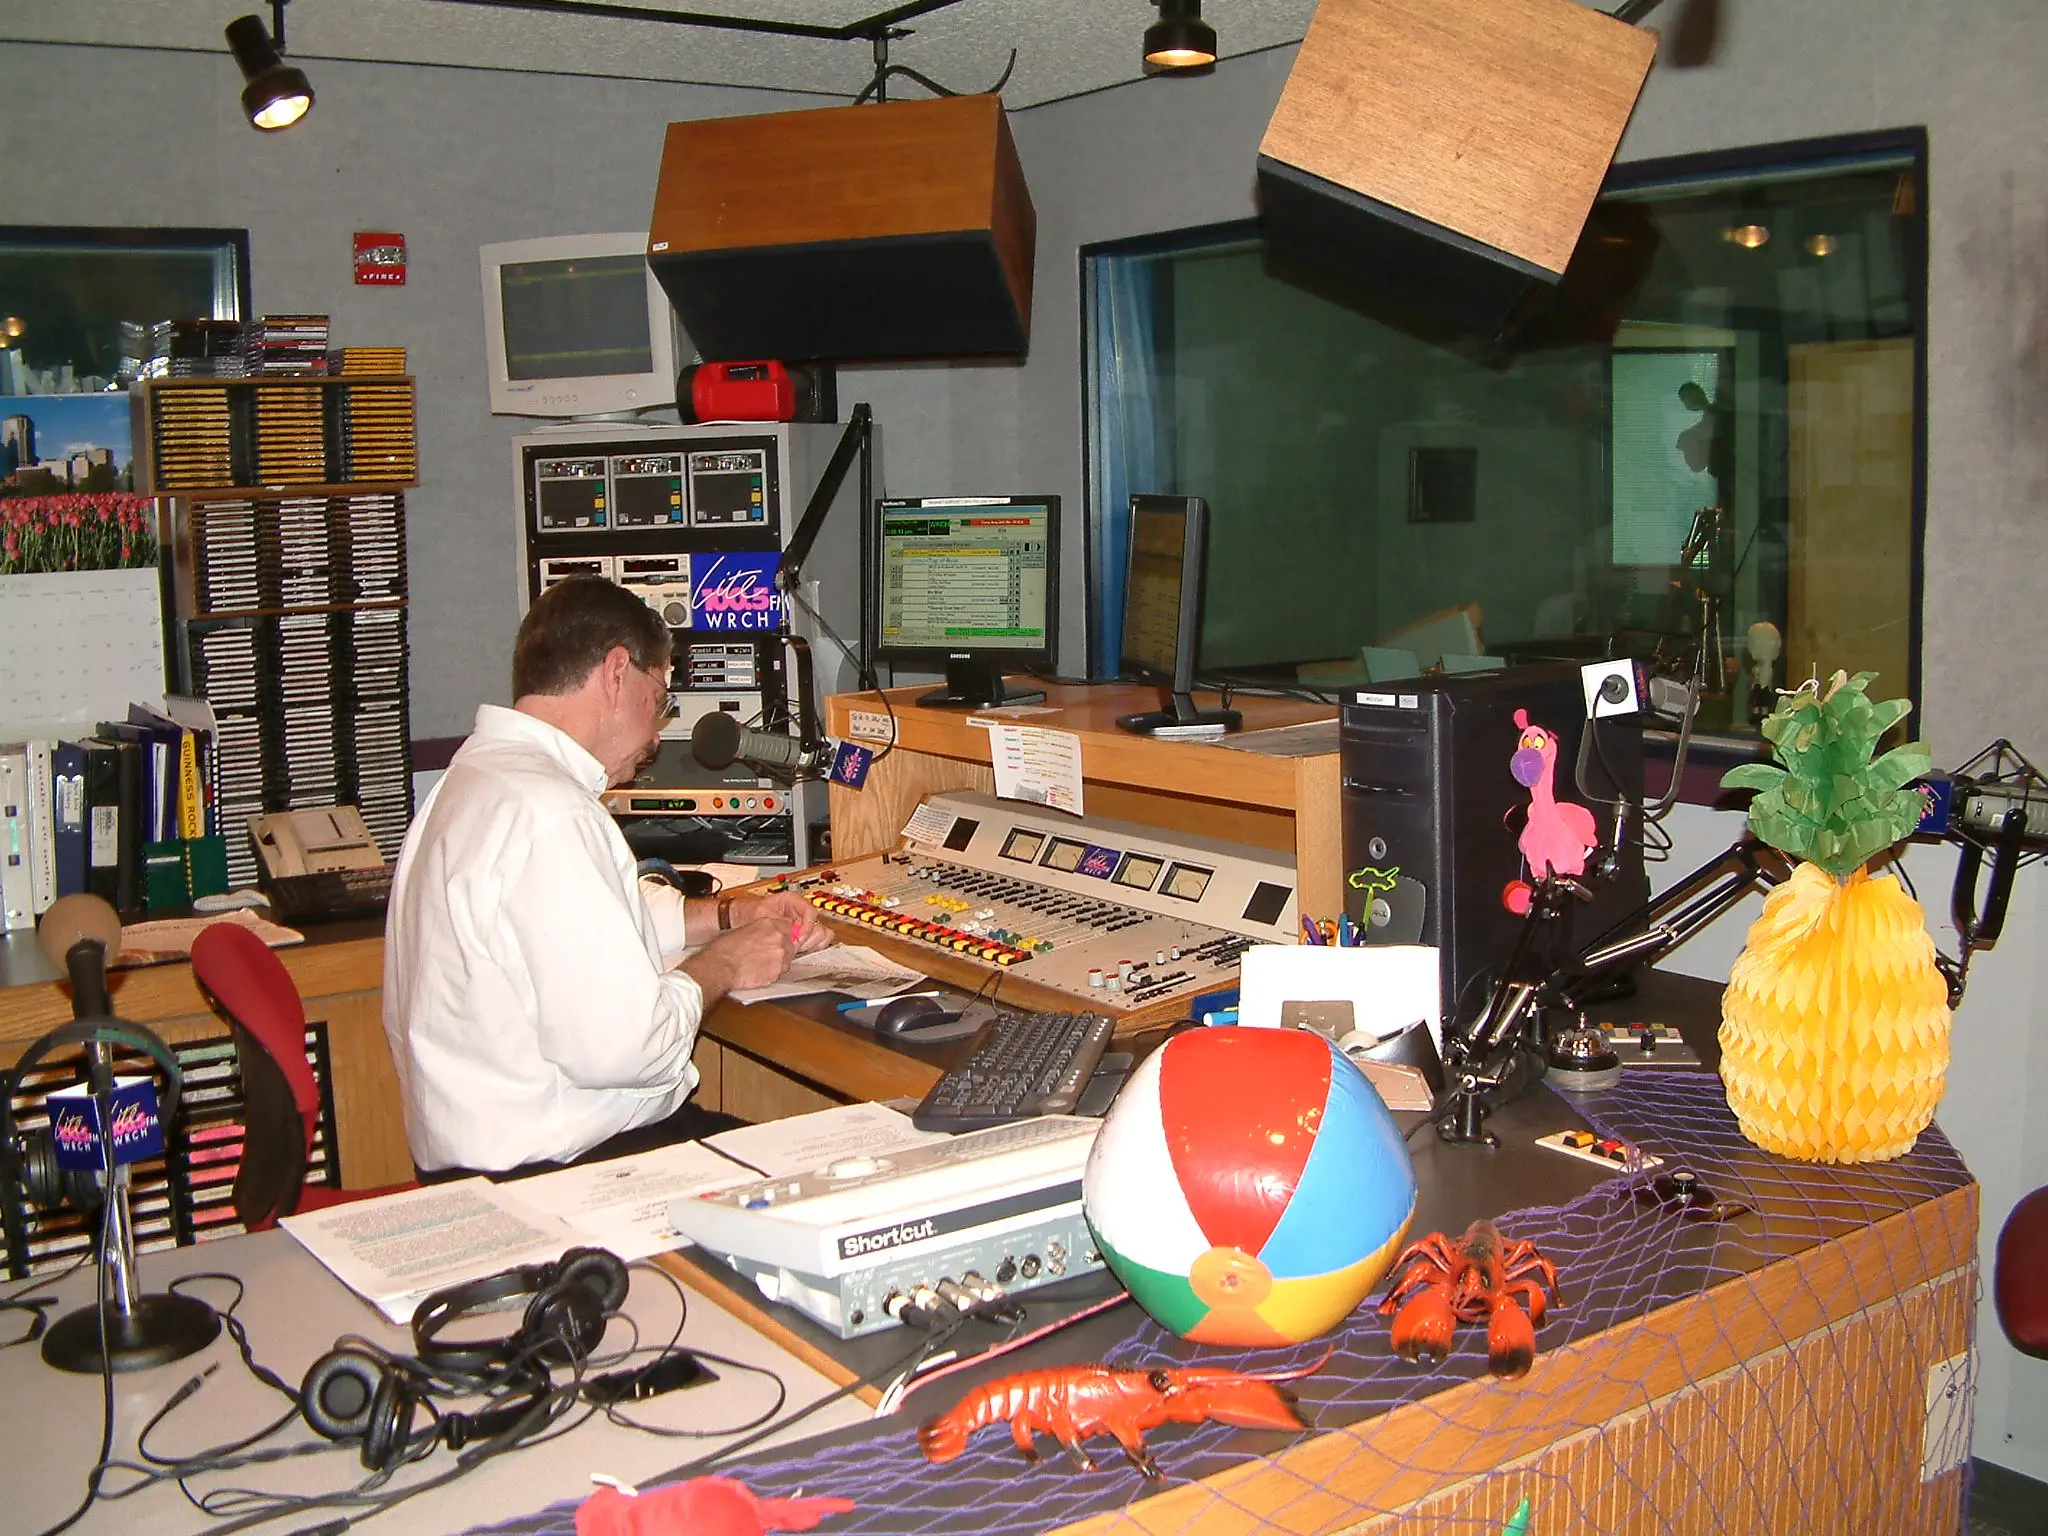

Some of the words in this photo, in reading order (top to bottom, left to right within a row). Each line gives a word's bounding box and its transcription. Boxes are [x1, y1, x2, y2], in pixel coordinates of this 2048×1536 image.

[692, 556, 763, 610] Lite
[705, 611, 769, 628] WRCH
[183, 741, 195, 801] GUINNESS
[187, 806, 197, 837] ROCK
[62, 1141, 91, 1152] WRCH
[113, 1128, 148, 1148] WRCH
